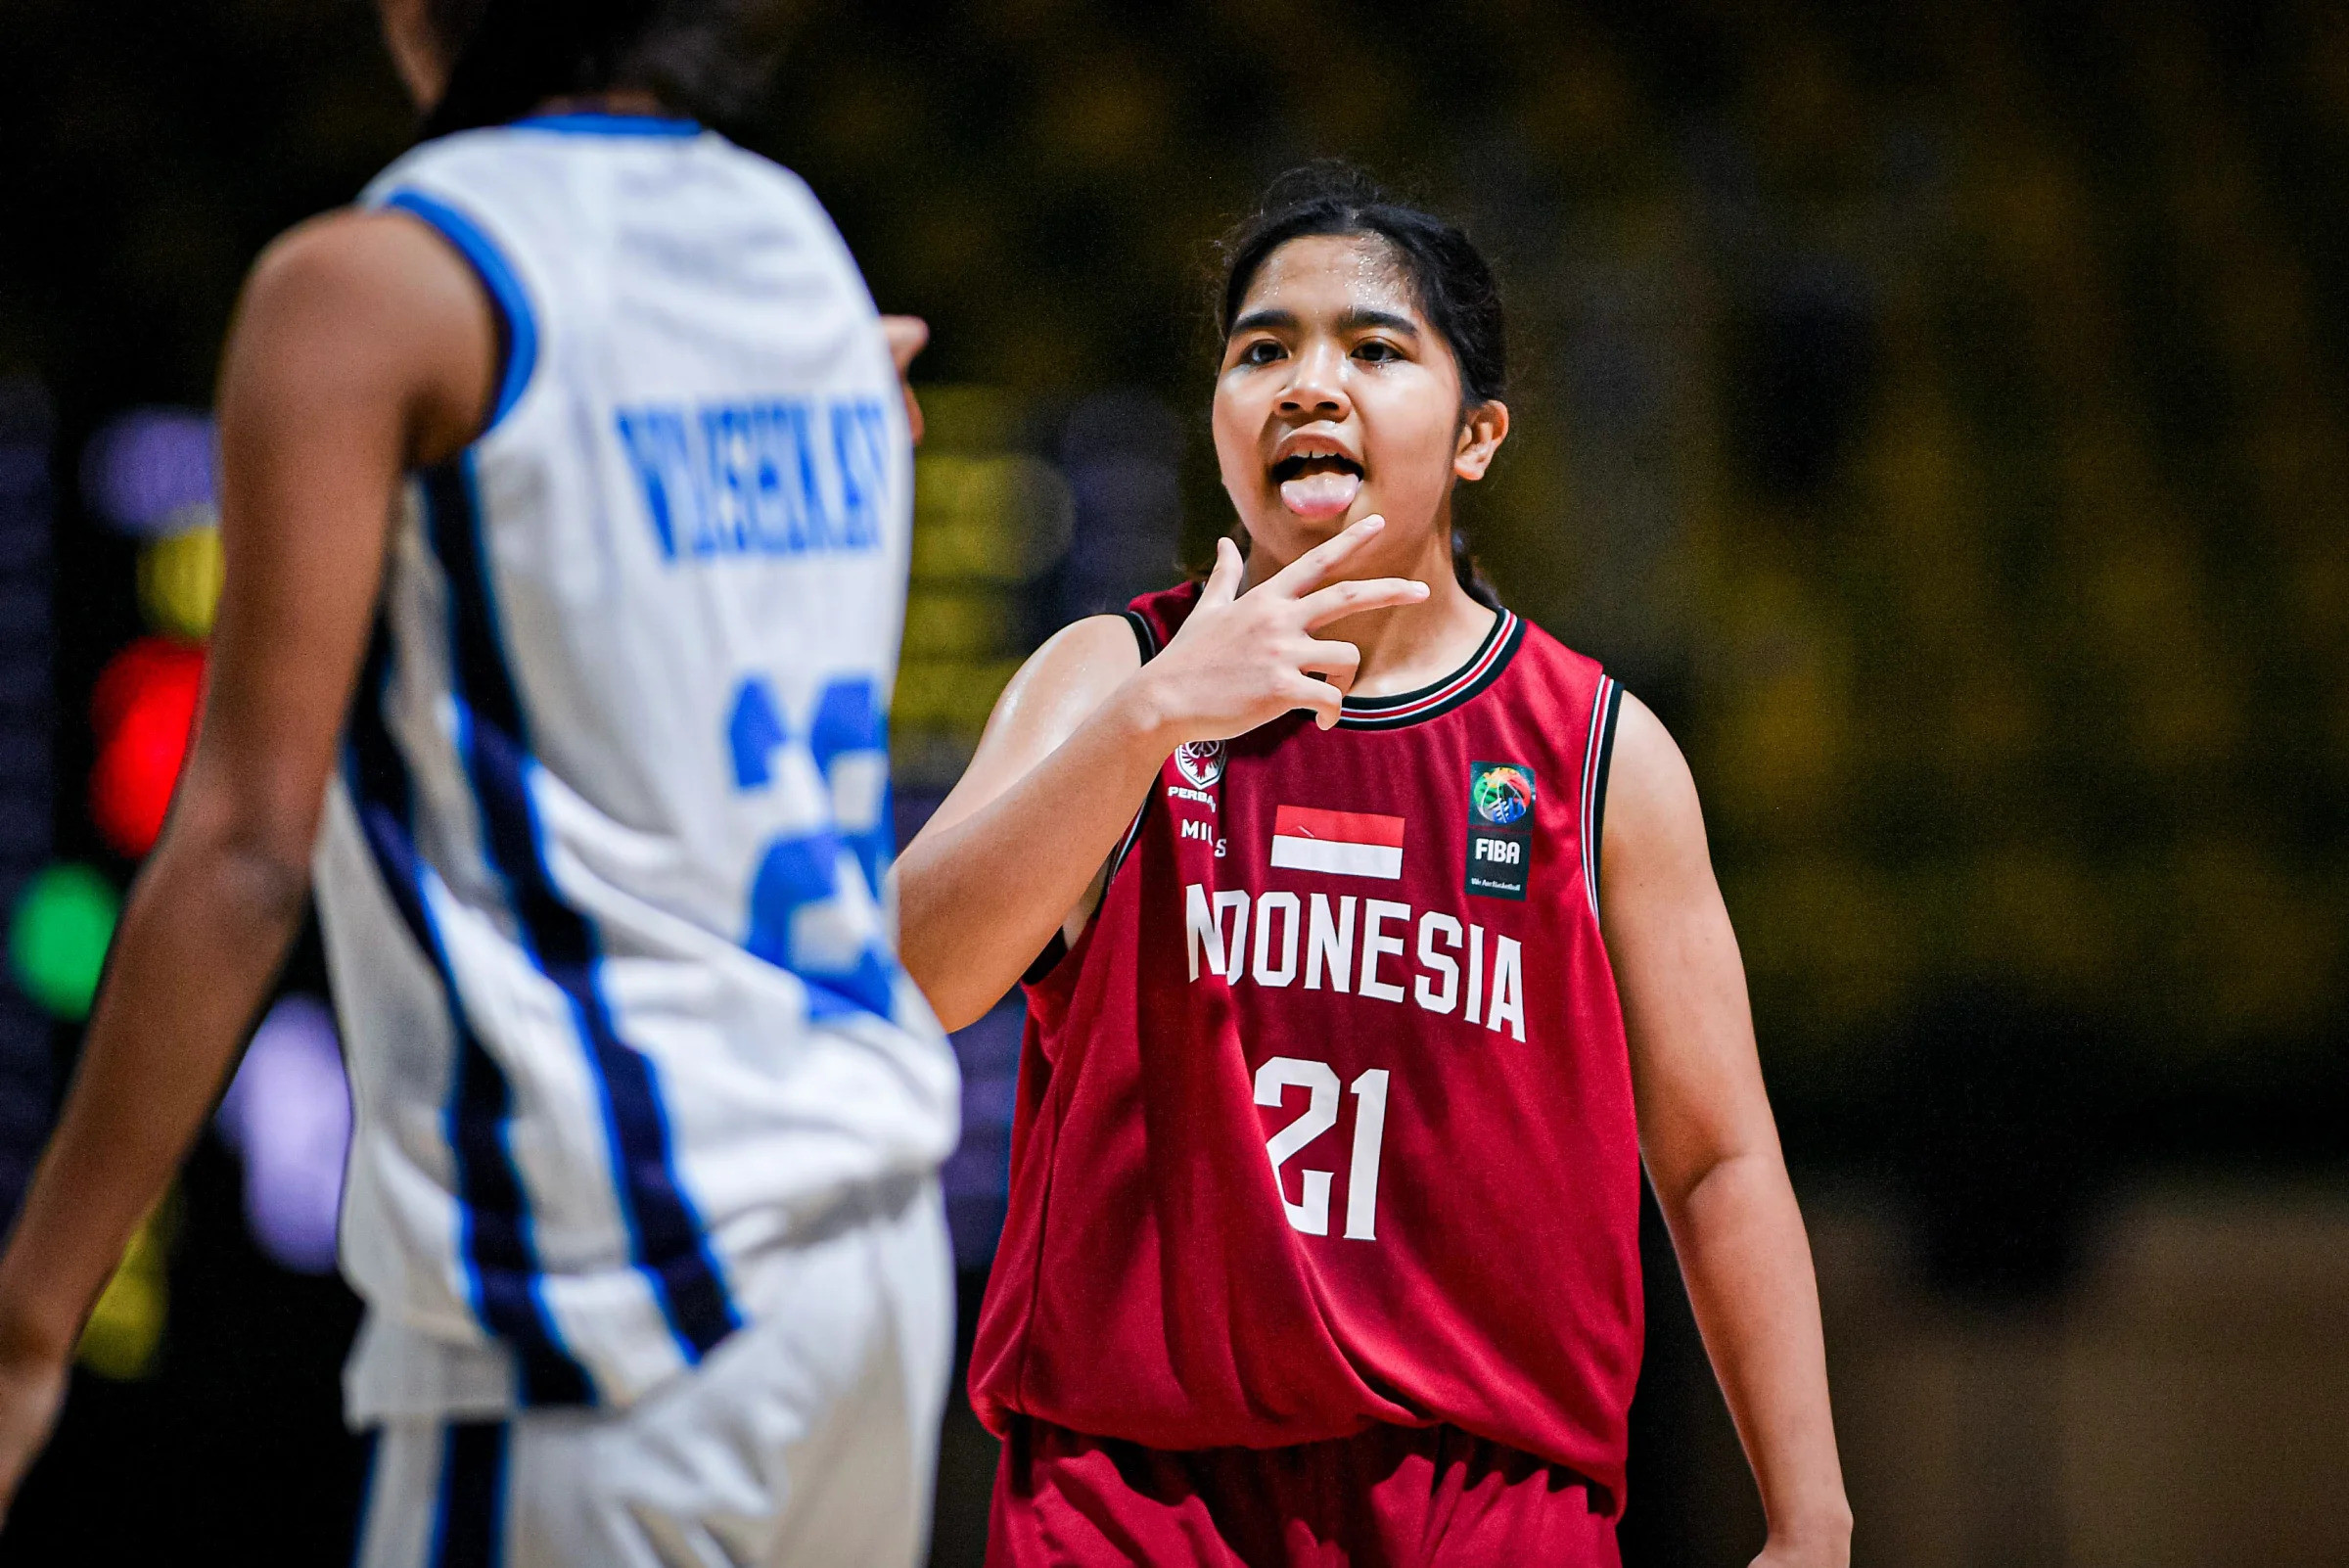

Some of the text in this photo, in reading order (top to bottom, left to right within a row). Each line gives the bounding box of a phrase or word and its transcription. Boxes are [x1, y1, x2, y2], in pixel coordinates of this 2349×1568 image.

[1168, 786, 1217, 812] PERBA
[1475, 838, 1520, 864] FIBA
[1185, 883, 1527, 1043] NDONESIA
[1253, 1056, 1390, 1241] 21
